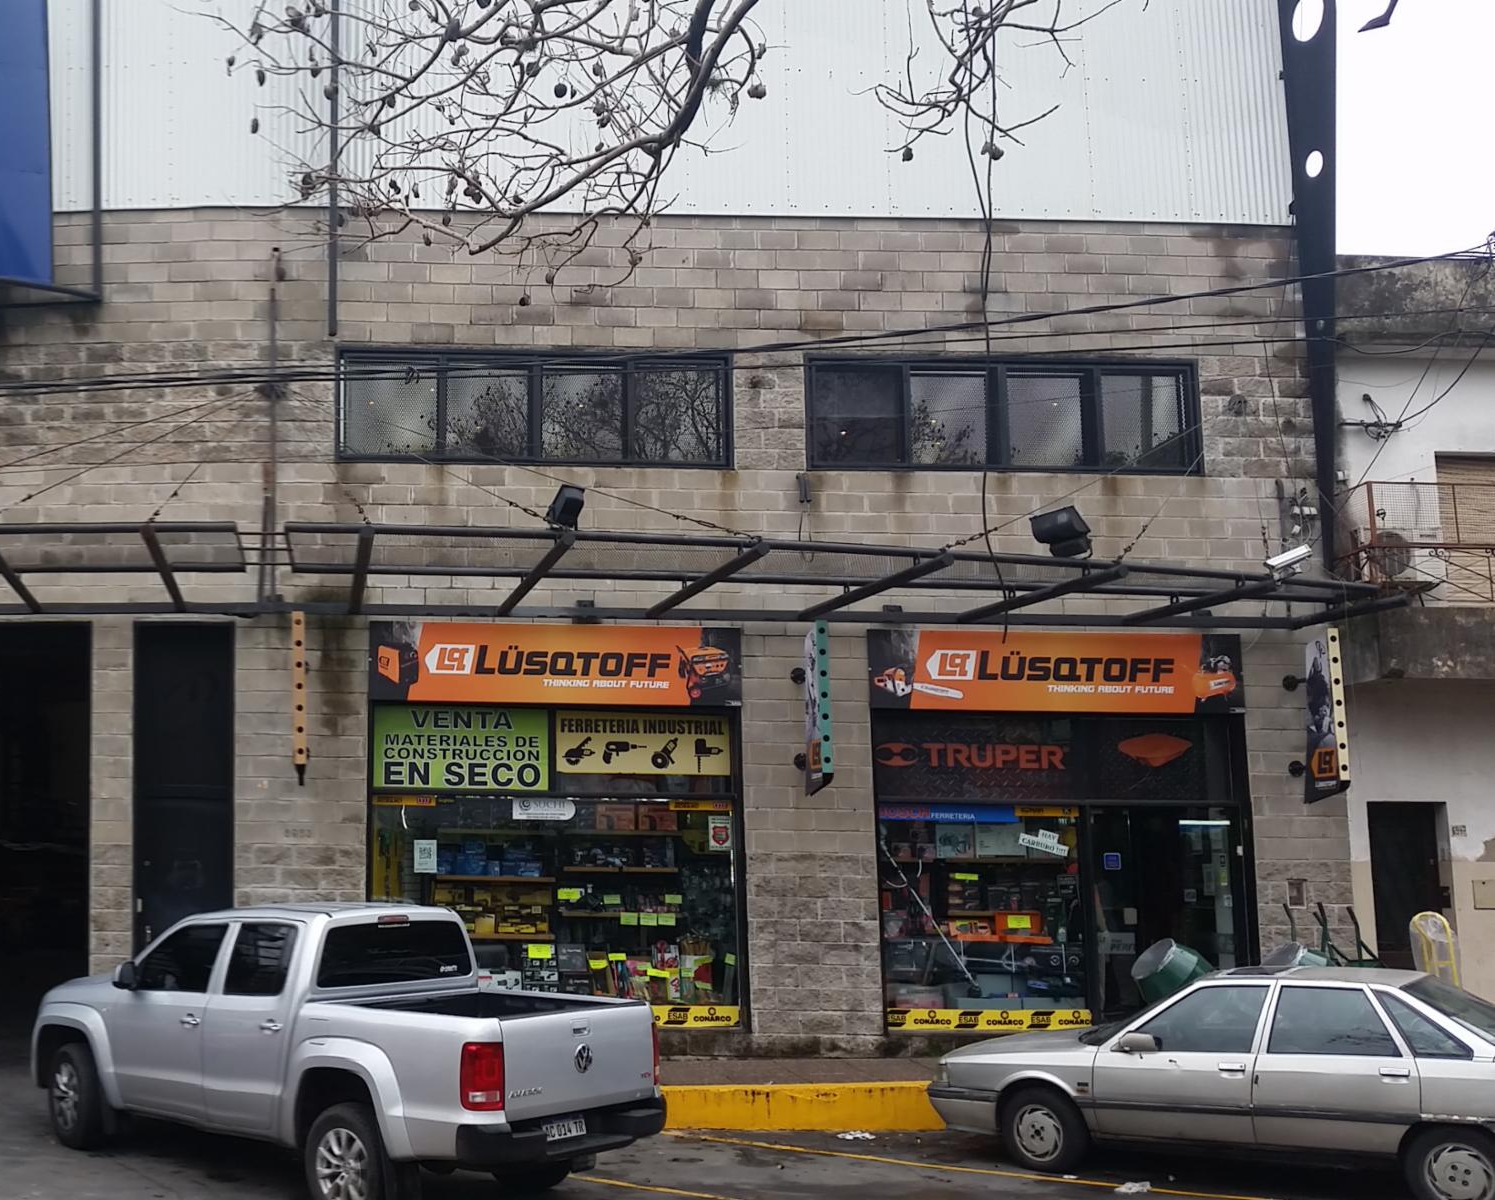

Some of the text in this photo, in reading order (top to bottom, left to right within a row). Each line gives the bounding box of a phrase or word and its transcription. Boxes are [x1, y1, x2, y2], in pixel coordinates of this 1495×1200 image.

[542, 678, 670, 689] THINKING ABOUT FUTURE
[1047, 684, 1174, 694] THINKING ABOUT FUTURE
[411, 709, 513, 730] VENTA
[560, 718, 725, 736] FERRETERIA INDUSTRIAL
[384, 733, 539, 748] MATERIALES DE
[384, 748, 540, 762] CONSTRUCCION
[922, 742, 1066, 770] TRUPER
[383, 761, 541, 788] EN SECO
[930, 813, 976, 821] FERRETERIA
[667, 1012, 688, 1020] ESAB
[958, 1015, 979, 1024] ESAB
[1030, 1016, 1051, 1024] ESAB
[573, 1120, 585, 1134] TR
